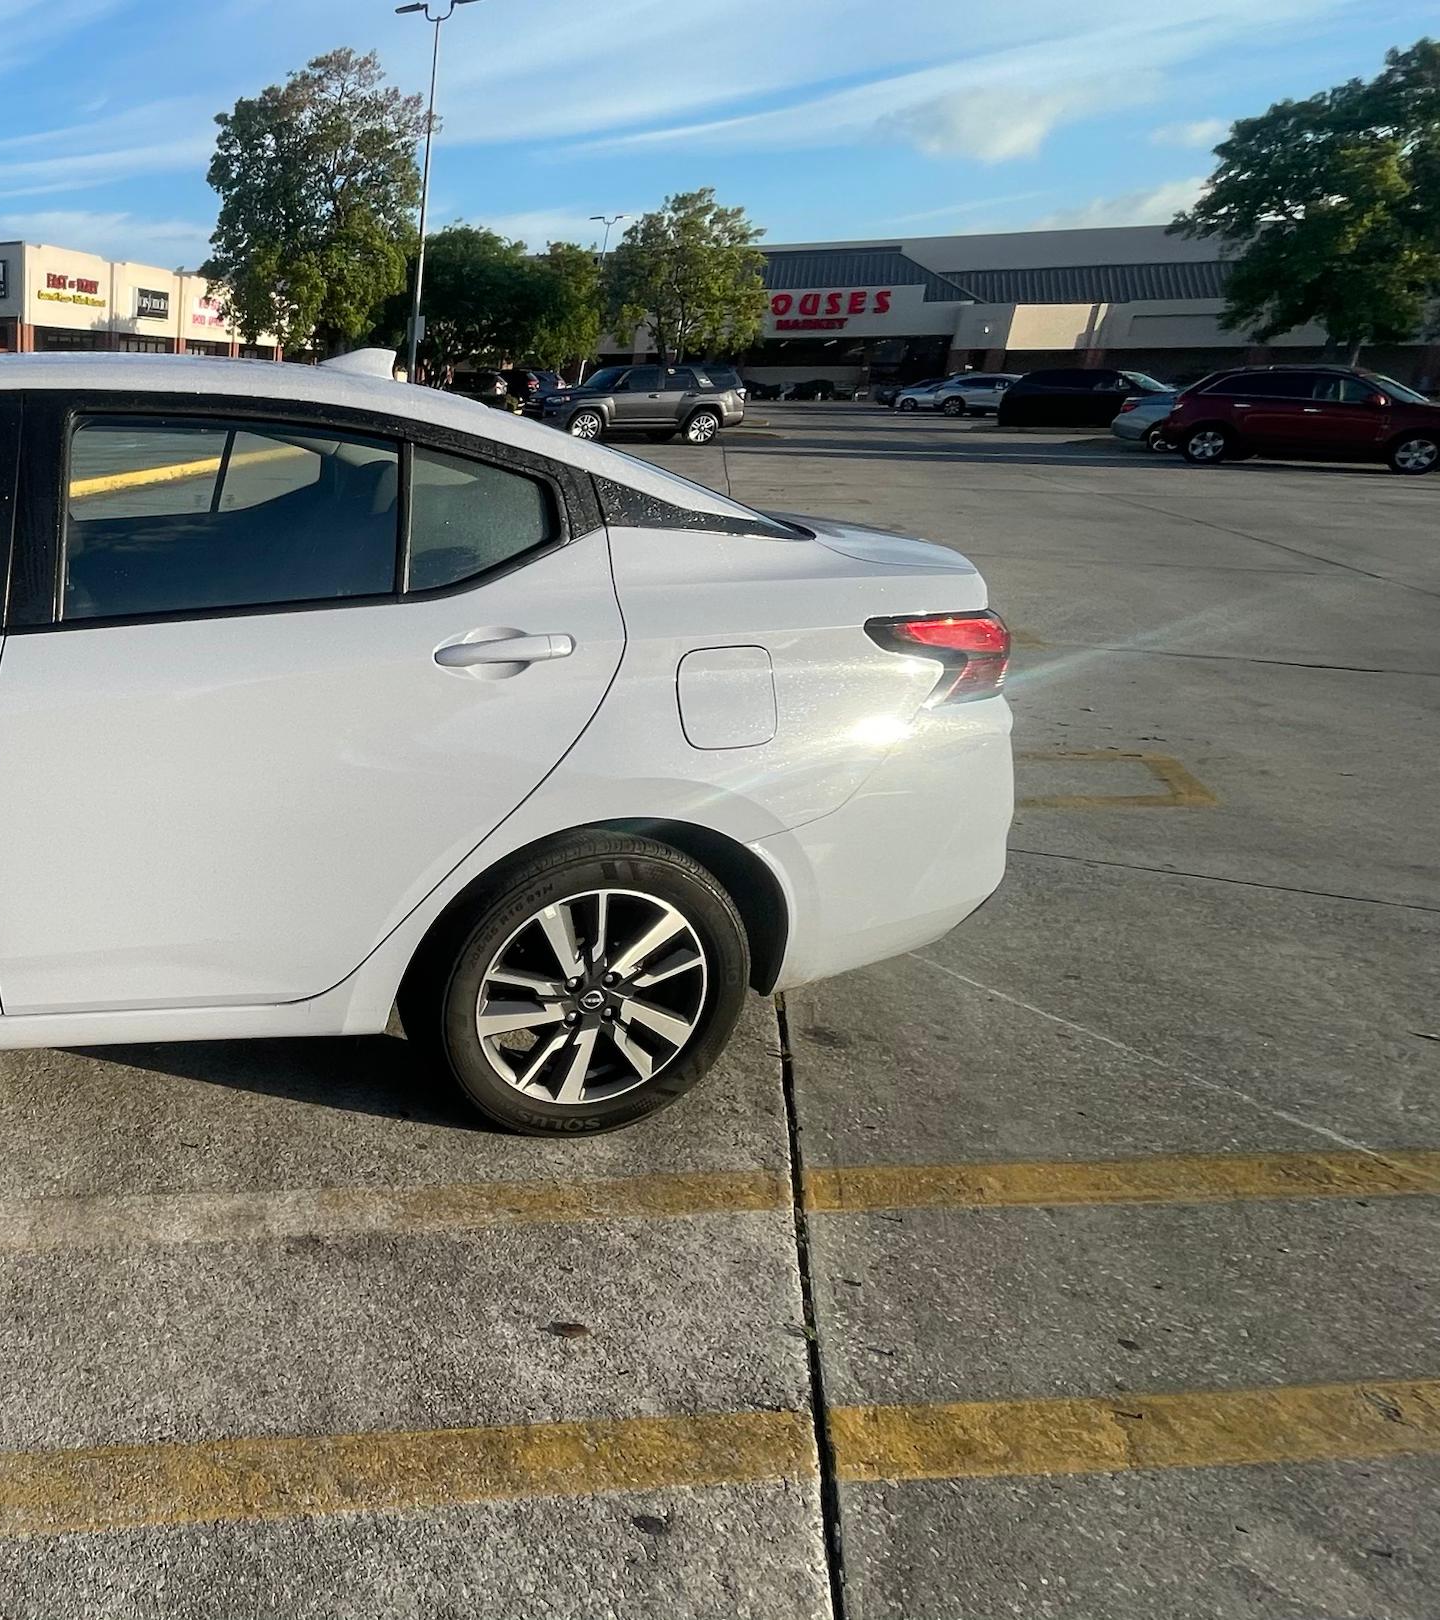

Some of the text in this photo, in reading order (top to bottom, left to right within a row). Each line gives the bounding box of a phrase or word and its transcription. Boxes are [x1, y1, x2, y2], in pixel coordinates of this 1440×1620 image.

[771, 290, 892, 316] OUSES
[775, 317, 849, 330] MARKET
[517, 1110, 602, 1131] SOLUS
